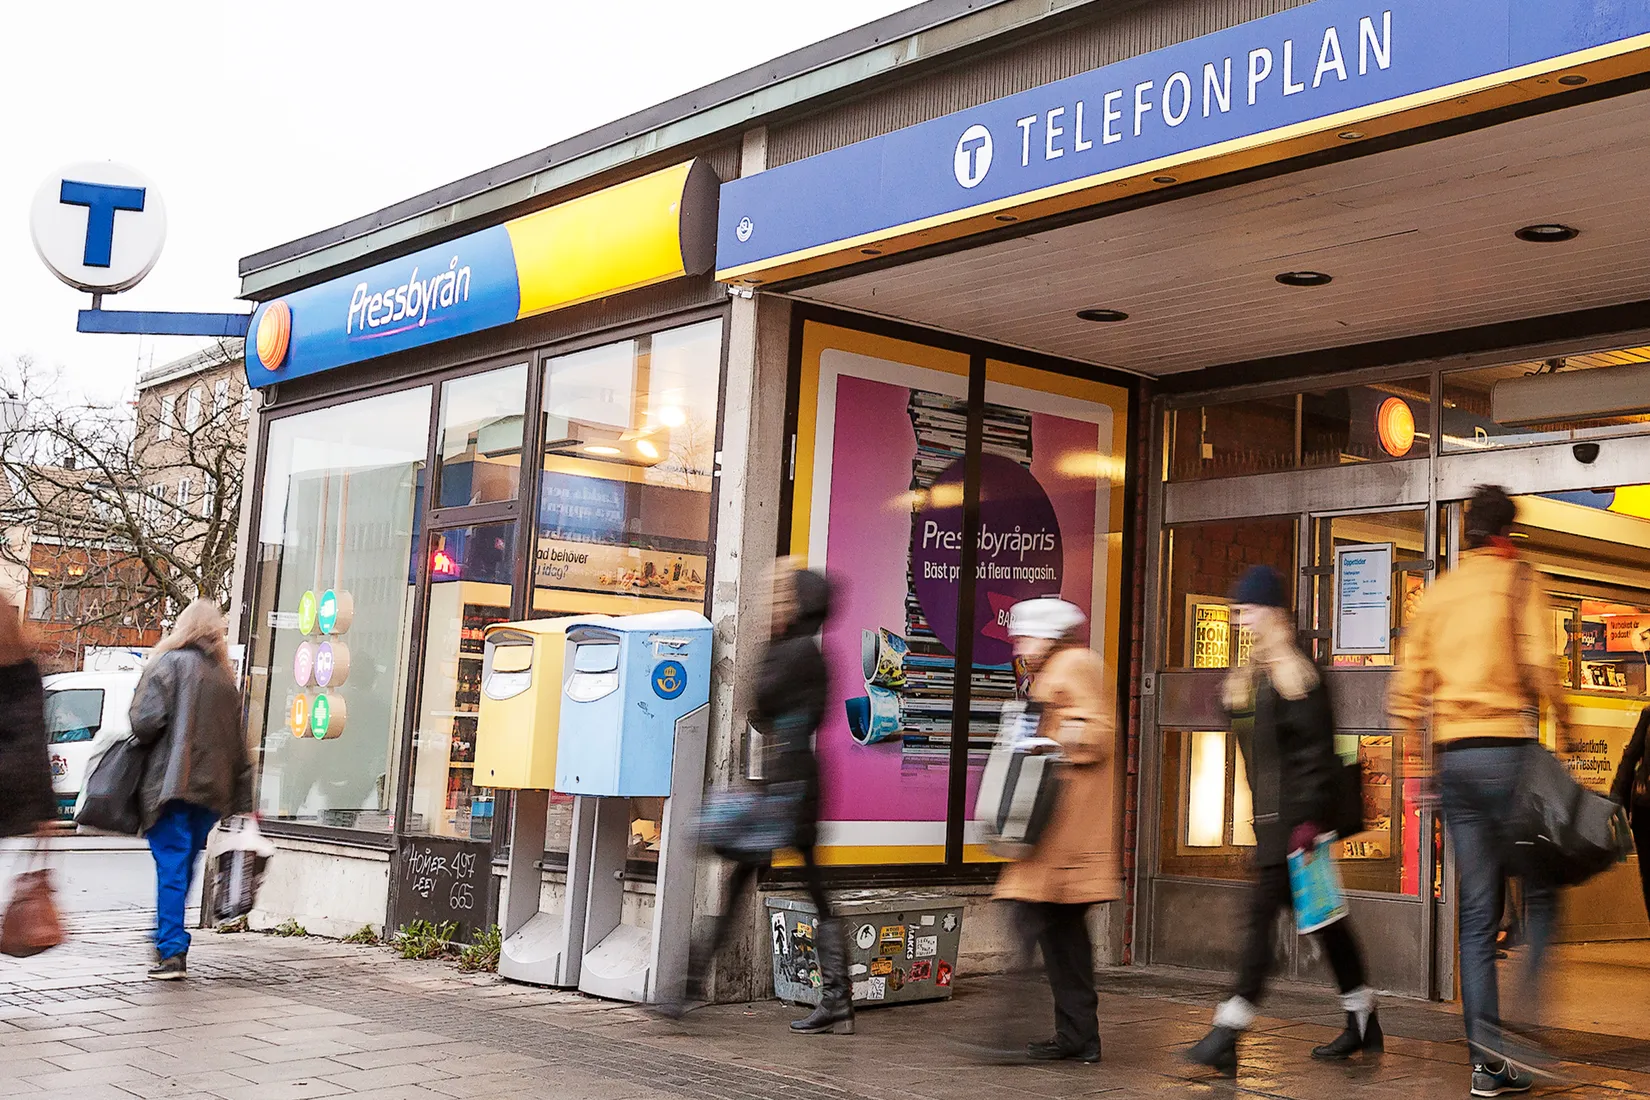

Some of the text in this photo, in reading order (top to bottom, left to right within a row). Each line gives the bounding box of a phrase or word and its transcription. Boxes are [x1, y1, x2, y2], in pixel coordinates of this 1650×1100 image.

[1016, 10, 1392, 167] TELEFONPLAN
[60, 178, 146, 268] T
[346, 255, 471, 335] Pressbyrån
[536, 548, 589, 565] ad behöver
[542, 564, 569, 579] idag?
[924, 561, 947, 579] Bäst
[987, 562, 1011, 580] flera
[1012, 564, 1057, 583] magasin.
[451, 851, 476, 879] 497
[450, 882, 474, 909] 665
